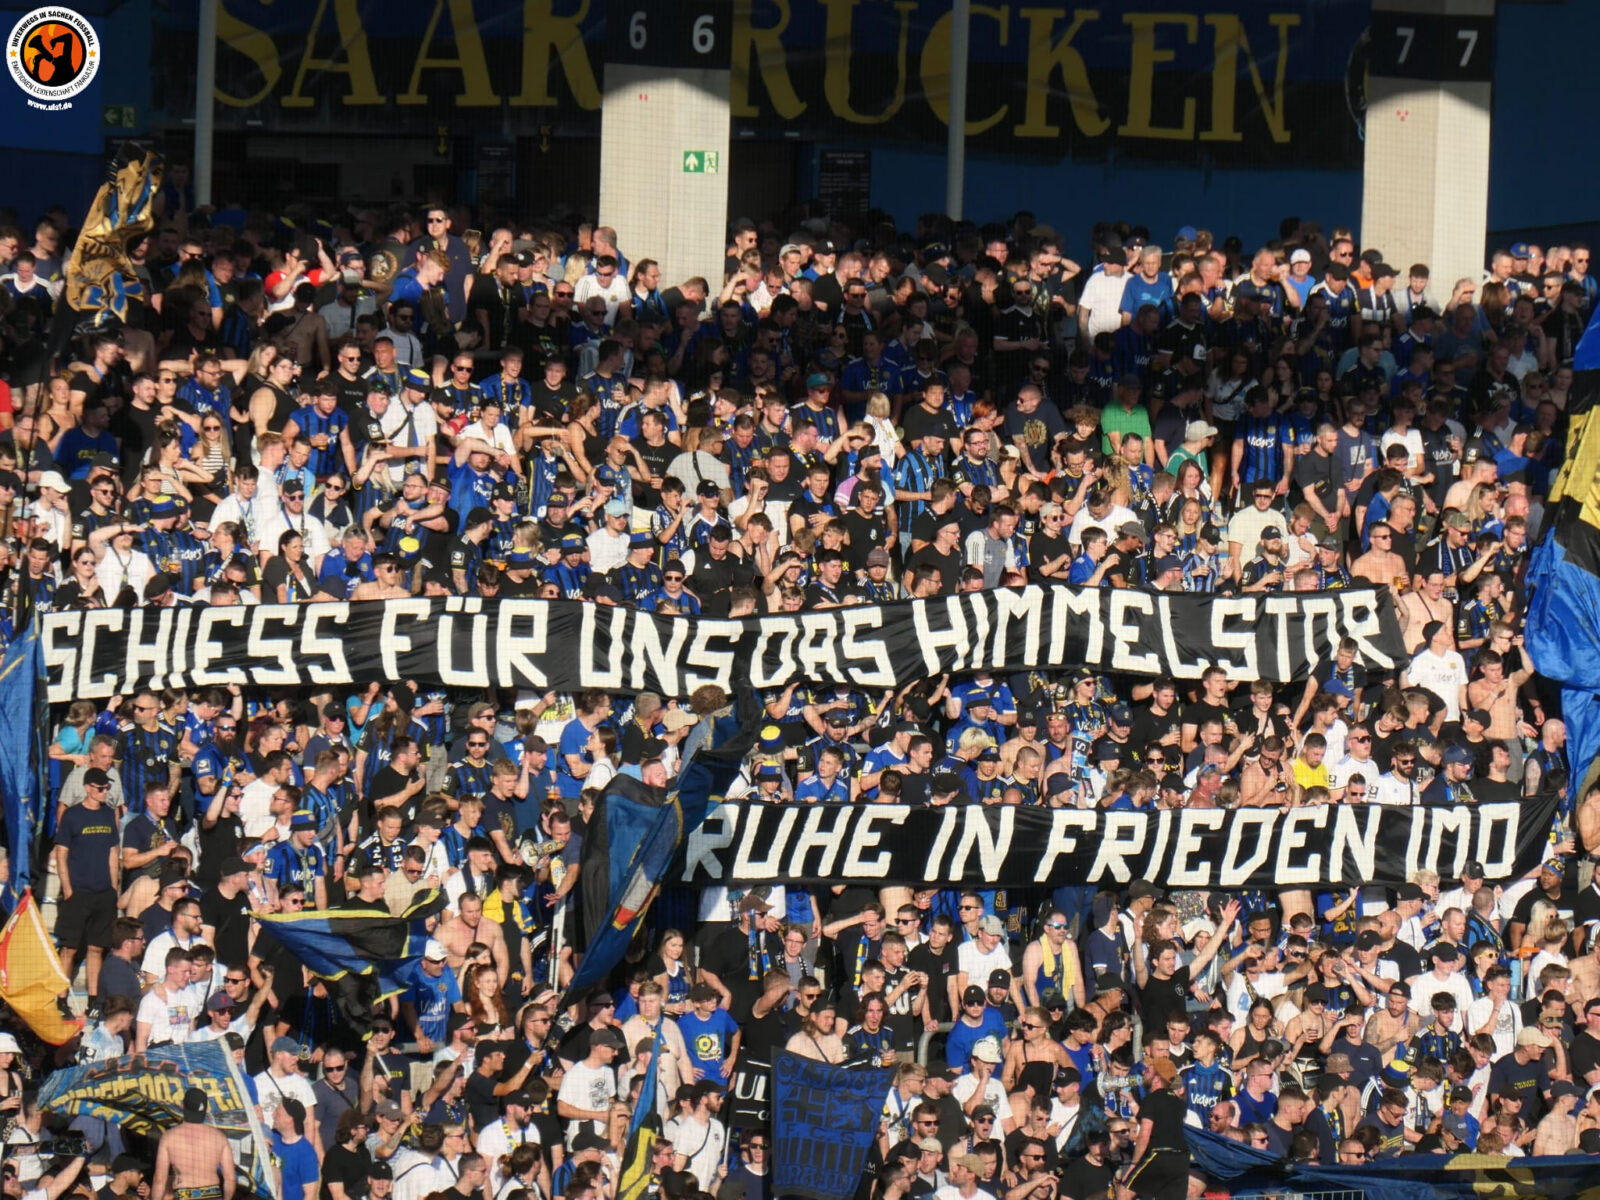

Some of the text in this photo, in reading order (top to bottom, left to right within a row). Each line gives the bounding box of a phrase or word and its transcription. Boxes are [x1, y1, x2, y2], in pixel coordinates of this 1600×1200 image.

[629, 12, 647, 50] 6
[692, 14, 715, 54] 6
[1396, 27, 1416, 65] 7
[1457, 29, 1479, 68] 7
[42, 601, 354, 703] SCHIESS
[380, 596, 548, 688] FÜR
[680, 802, 1521, 886] RUHE IN FRIEDEN IMO
